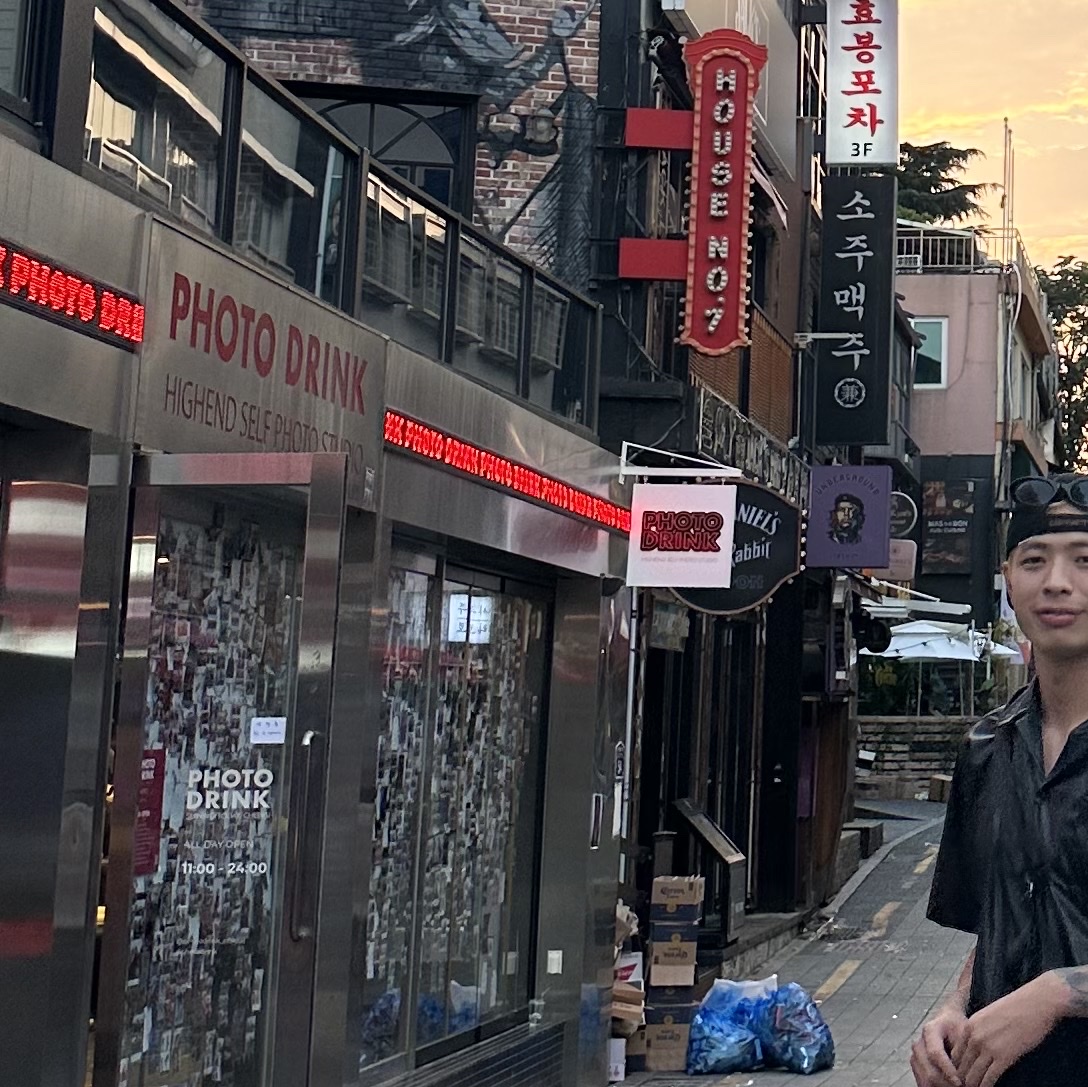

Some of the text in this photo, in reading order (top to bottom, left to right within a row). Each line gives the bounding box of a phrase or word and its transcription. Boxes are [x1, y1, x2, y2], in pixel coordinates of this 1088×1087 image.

[710, 68, 737, 218] HOUSE
[851, 143, 873, 157] 3F
[10, 252, 96, 321] PHOTO
[170, 272, 368, 416] PHOTO DRINK
[164, 373, 237, 432] HIGHEND
[239, 401, 272, 443] SELF
[273, 413, 318, 453] PHOTO
[642, 511, 724, 532] PHOTO
[735, 503, 782, 535] NIEL'S
[640, 529, 721, 551] DRINK
[188, 768, 274, 789] PHOTO
[186, 789, 271, 810] DRINK
[204, 839, 225, 848] DAY
[182, 862, 215, 874] 11:00
[227, 862, 267, 874] 24:00
